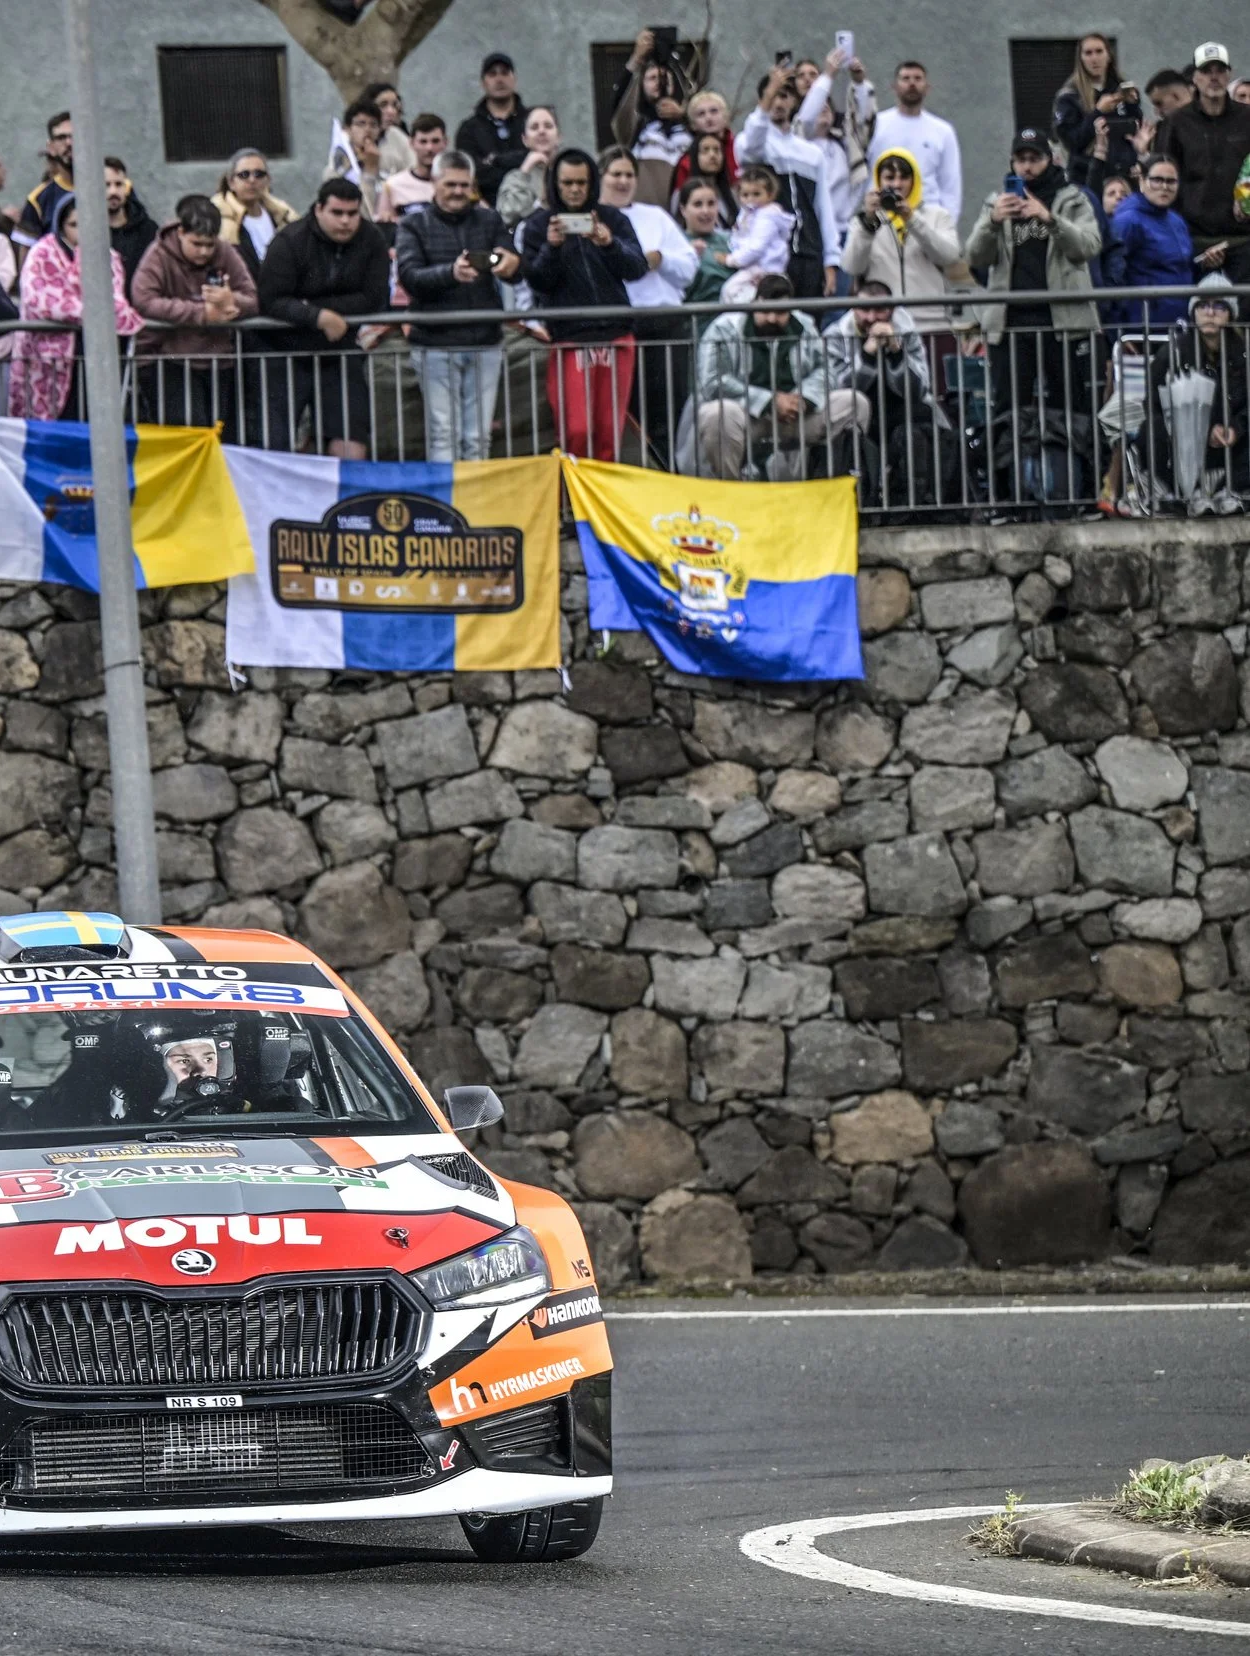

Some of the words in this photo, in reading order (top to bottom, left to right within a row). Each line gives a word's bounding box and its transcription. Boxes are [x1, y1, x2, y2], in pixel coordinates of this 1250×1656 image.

[277, 528, 331, 563] RALLY
[337, 533, 400, 567] ISLAS
[405, 535, 516, 568] CANARIAS
[75, 1036, 100, 1046] OMP
[265, 1028, 290, 1039] OMP
[64, 1163, 380, 1181] CARLSSON
[54, 1215, 322, 1255] MOTUL
[489, 1357, 586, 1401] HYRMASKINER
[171, 1398, 192, 1407] NR
[197, 1397, 207, 1407] S
[212, 1397, 237, 1406] 109
